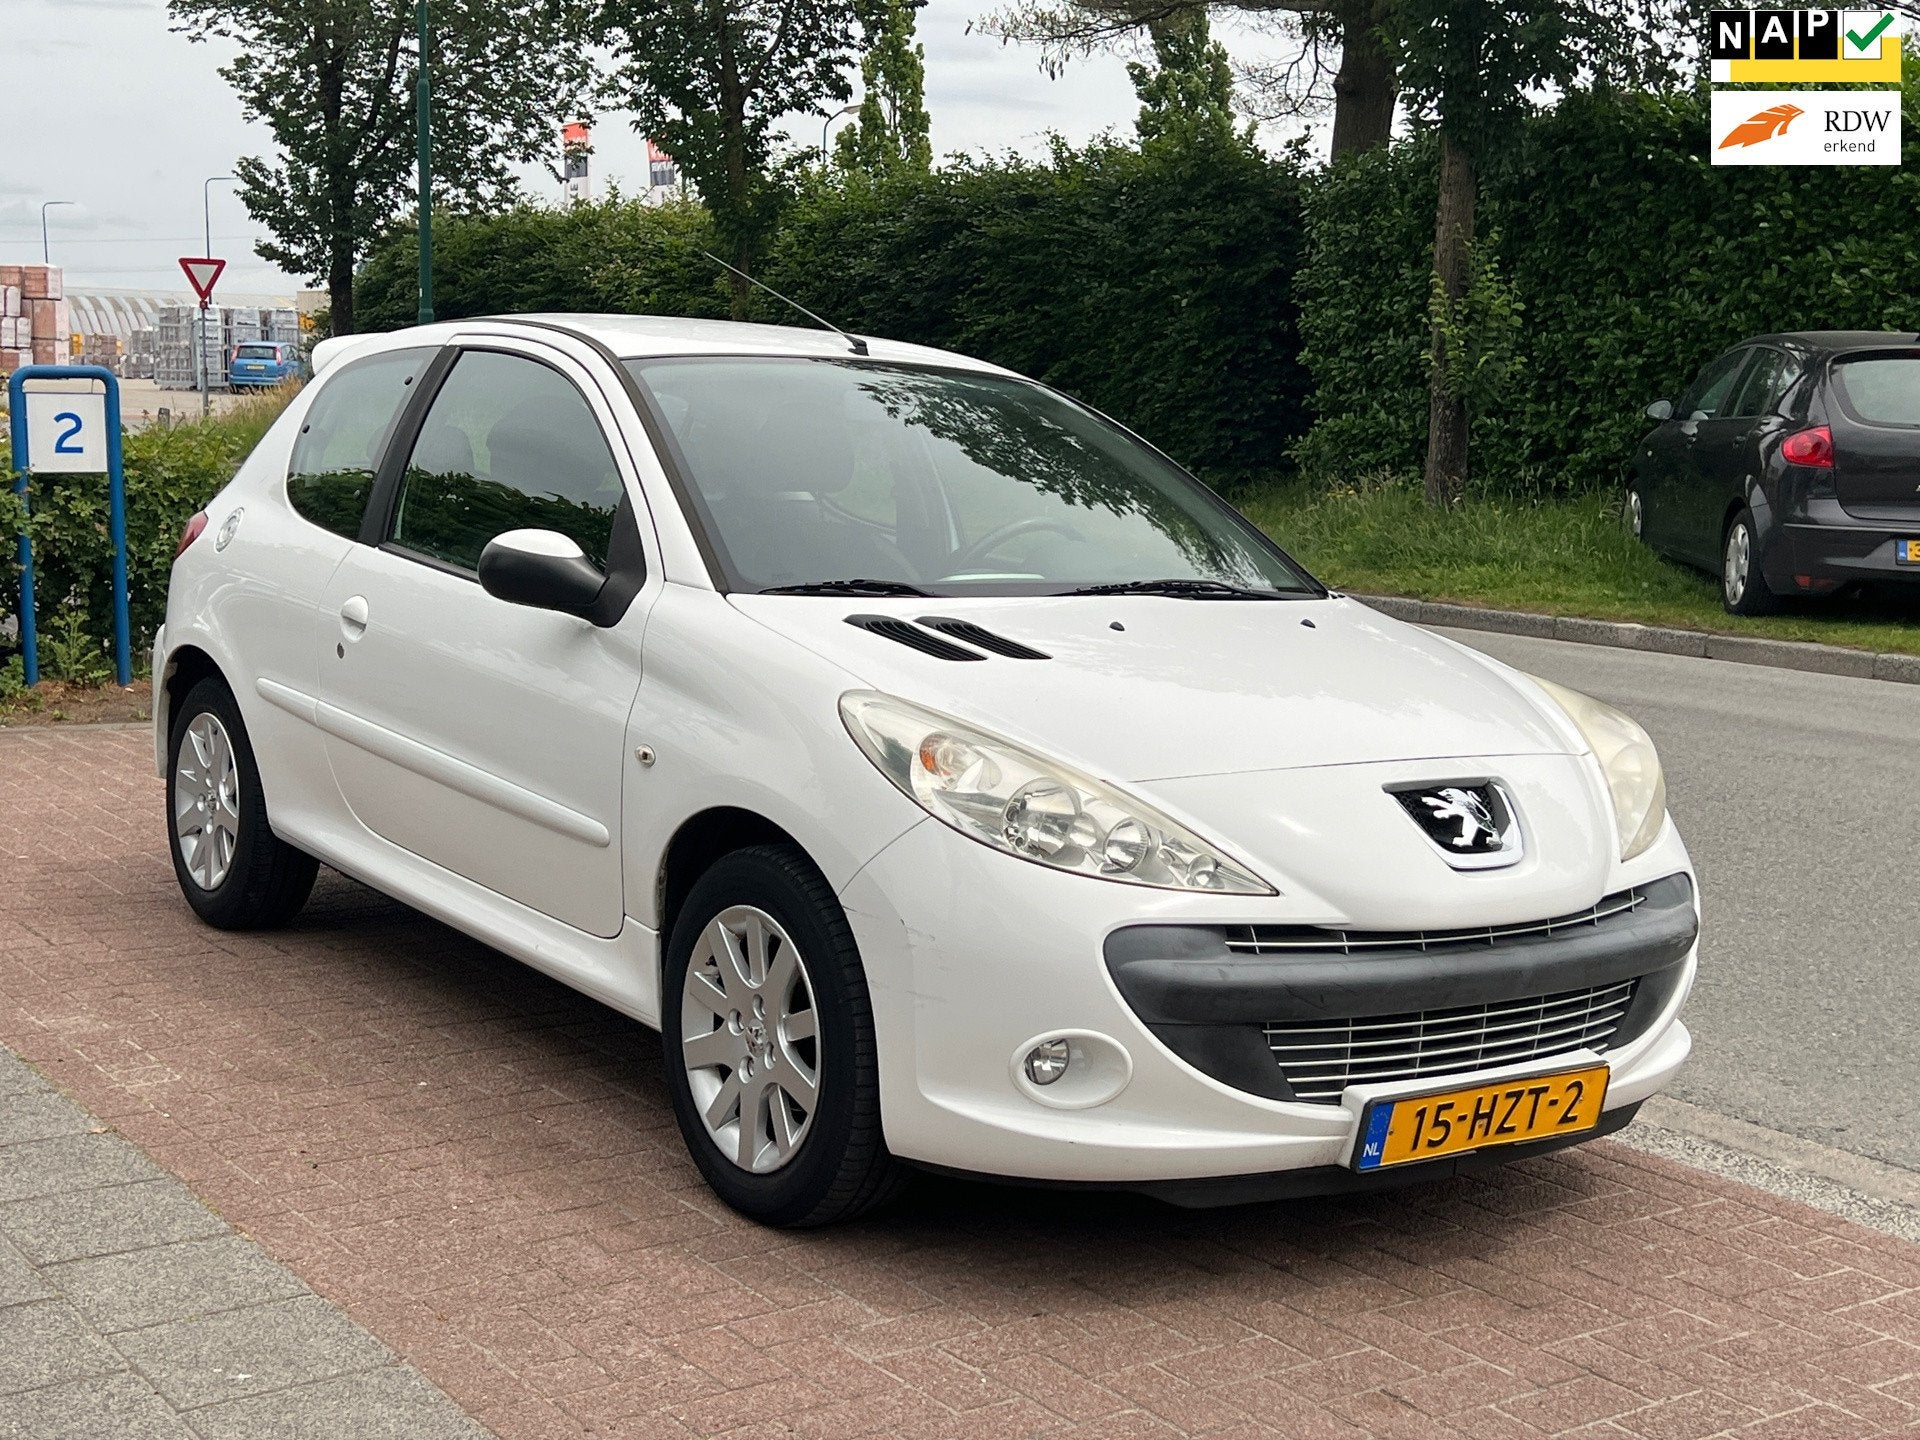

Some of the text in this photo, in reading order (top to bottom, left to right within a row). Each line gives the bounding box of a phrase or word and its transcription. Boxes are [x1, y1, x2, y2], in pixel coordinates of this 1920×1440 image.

[54, 412, 84, 453] 2
[1411, 1080, 1585, 1151] 15-HZT-2
[1362, 1142, 1380, 1158] NL
